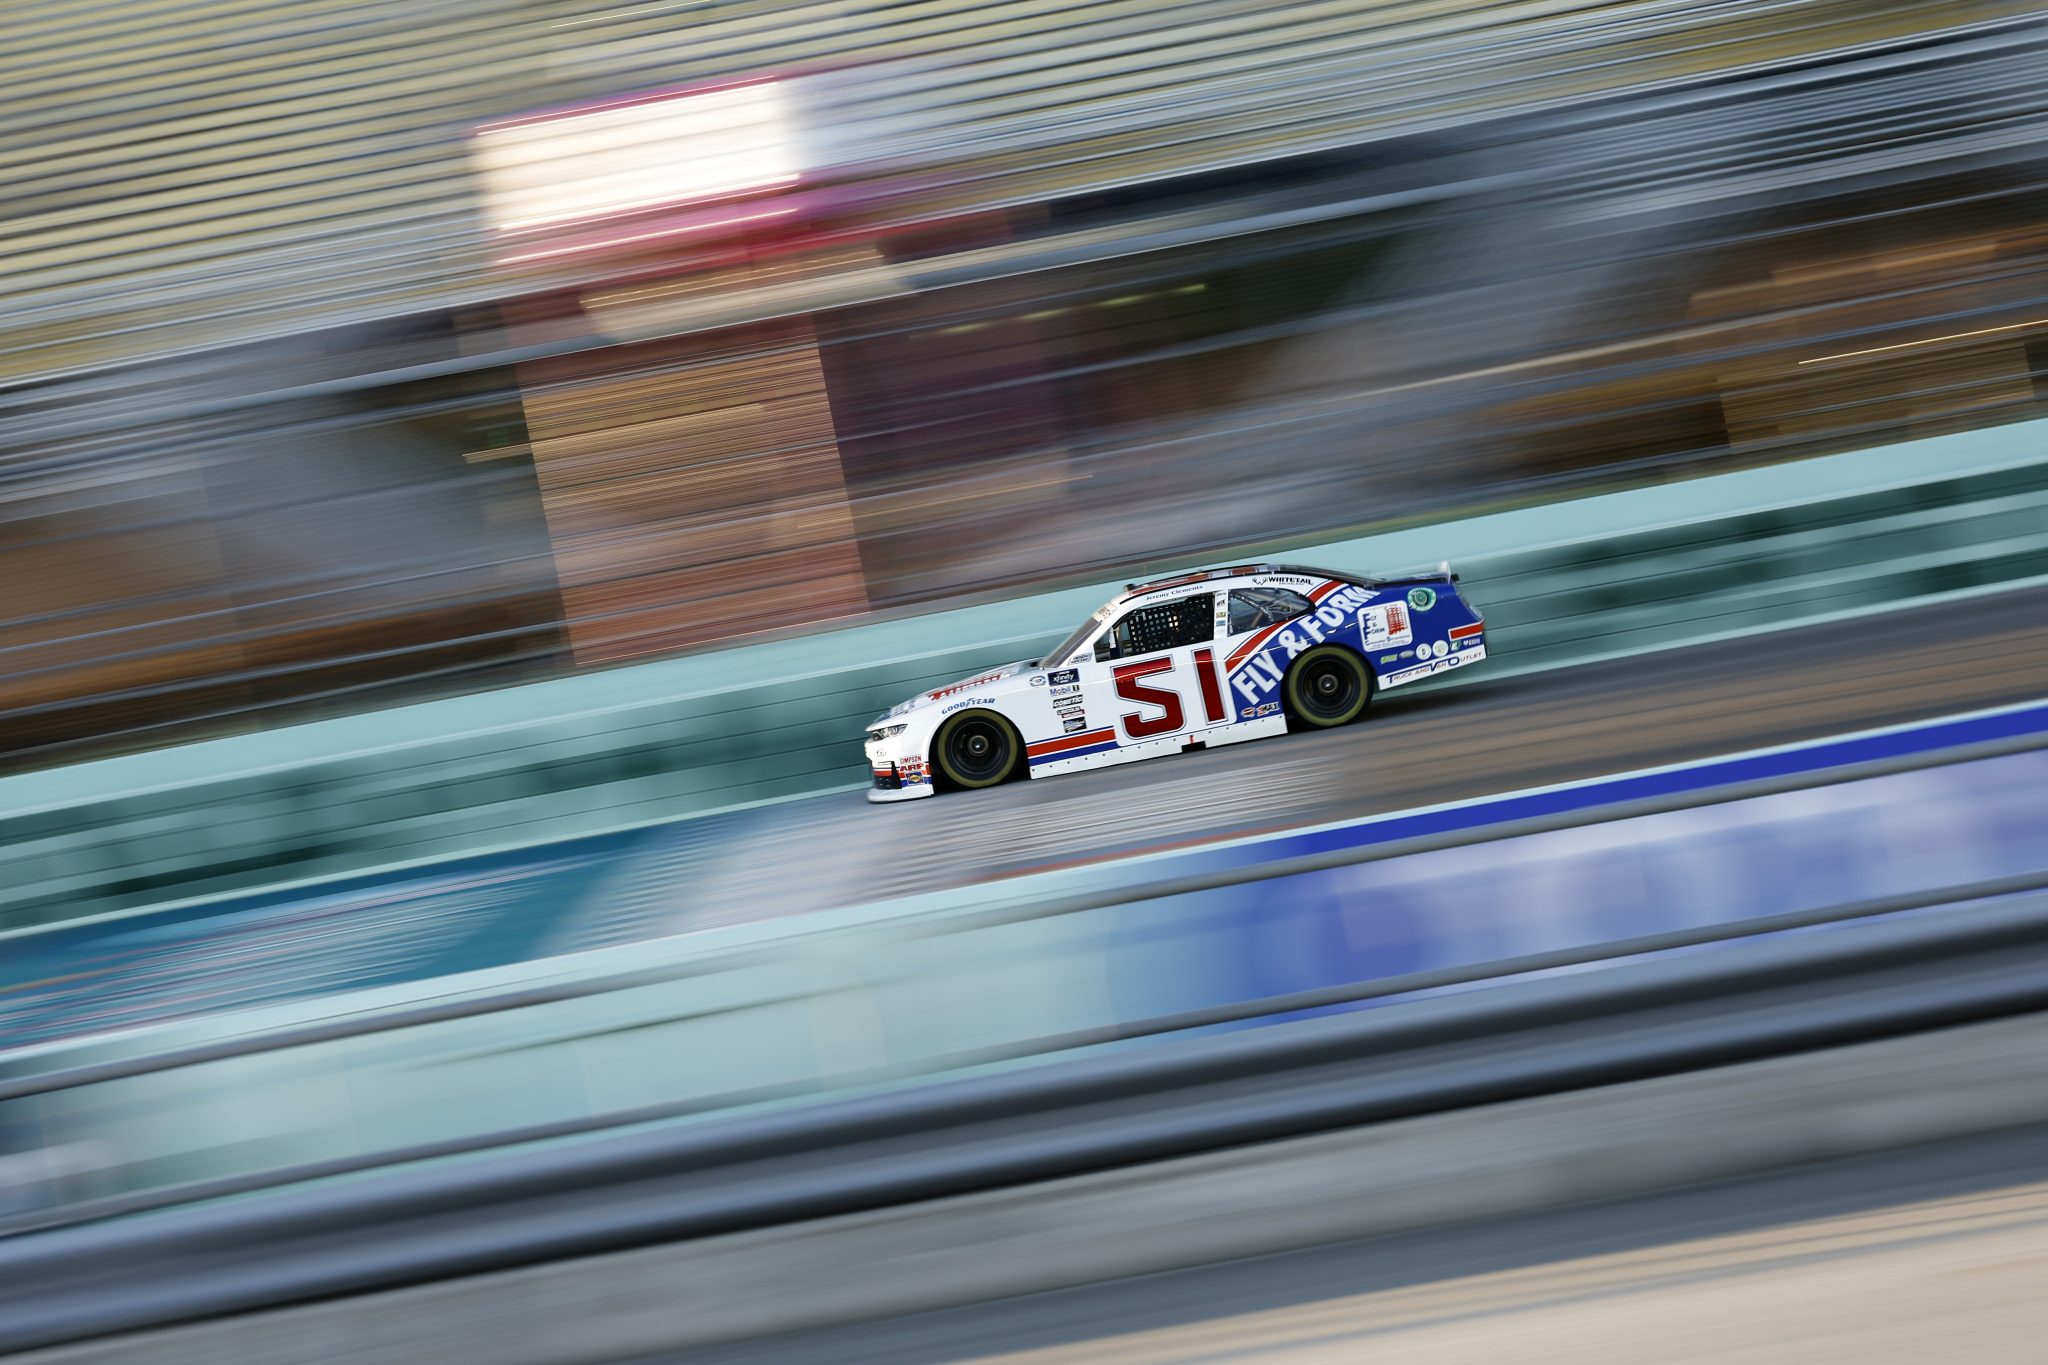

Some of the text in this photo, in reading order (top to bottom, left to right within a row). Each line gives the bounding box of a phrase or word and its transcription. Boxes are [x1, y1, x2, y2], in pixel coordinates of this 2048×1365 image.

[1146, 585, 1204, 601] Jeremy Clements
[1231, 650, 1284, 705] FLY
[1297, 585, 1381, 644] FORM
[1386, 670, 1413, 684] TRUCK
[1448, 652, 1483, 666] OUTLET
[1053, 673, 1075, 683] xfinity
[1050, 685, 1071, 697] Mobil
[1110, 646, 1229, 740] 51
[941, 697, 996, 715] GOODYEAR
[1054, 696, 1083, 707] COMETIC
[900, 754, 922, 764] SIMPSON
[900, 763, 924, 772] ARP
